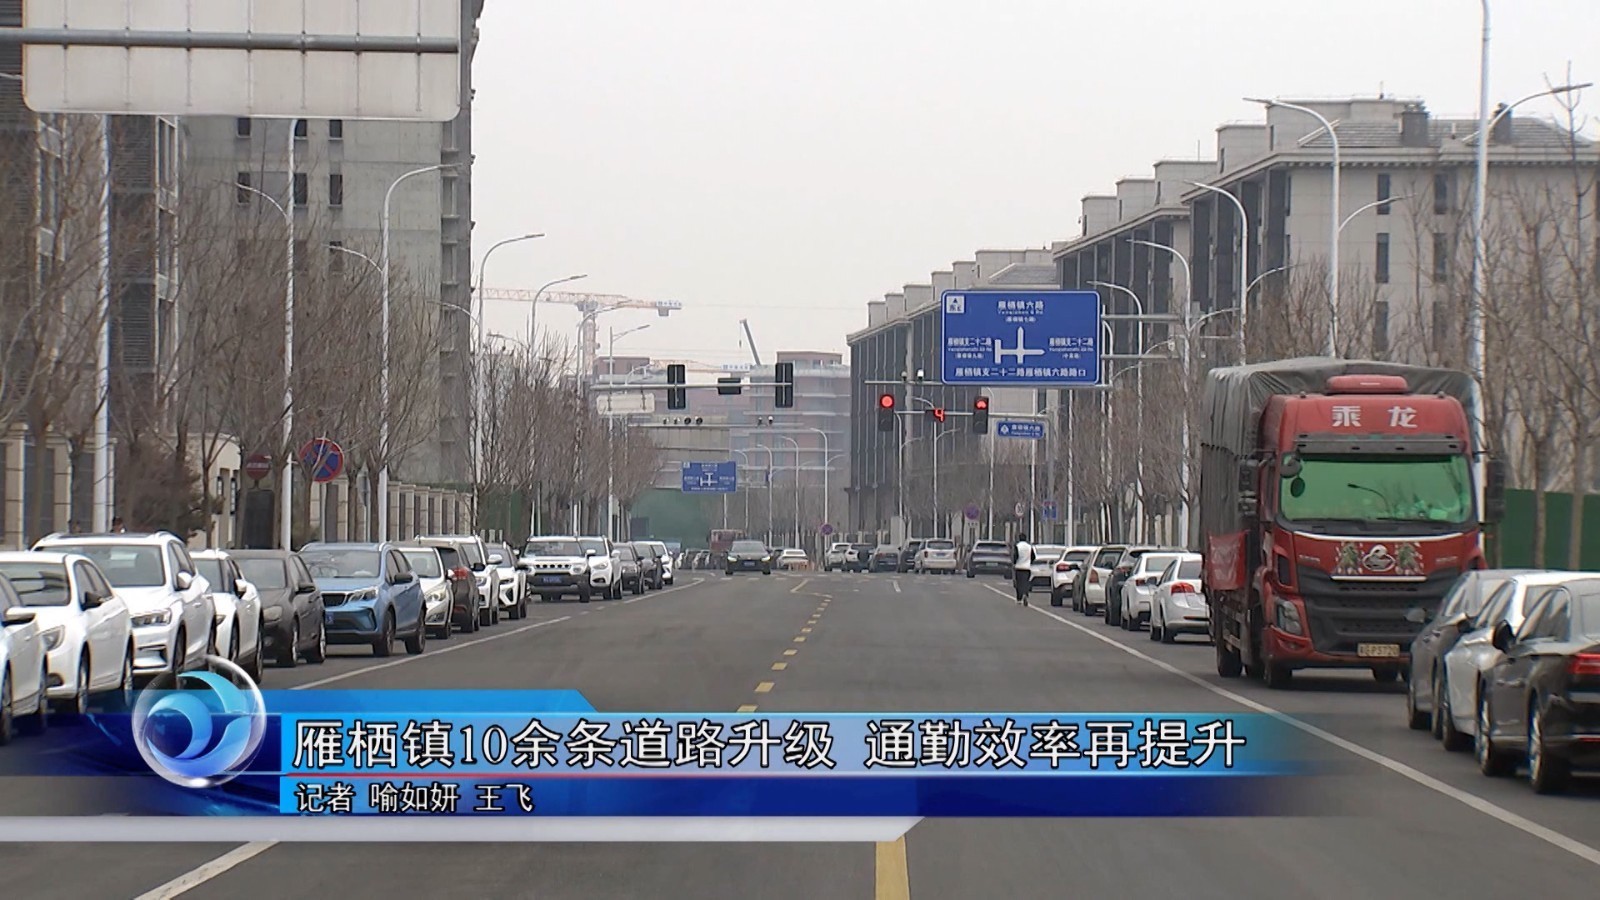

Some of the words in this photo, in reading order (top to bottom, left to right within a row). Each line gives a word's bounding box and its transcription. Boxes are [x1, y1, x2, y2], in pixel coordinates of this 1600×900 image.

[998, 301, 1044, 310] 雁栖镇六路
[954, 368, 1086, 378] 雁栖镇支二十二路雁栖镇六路路口
